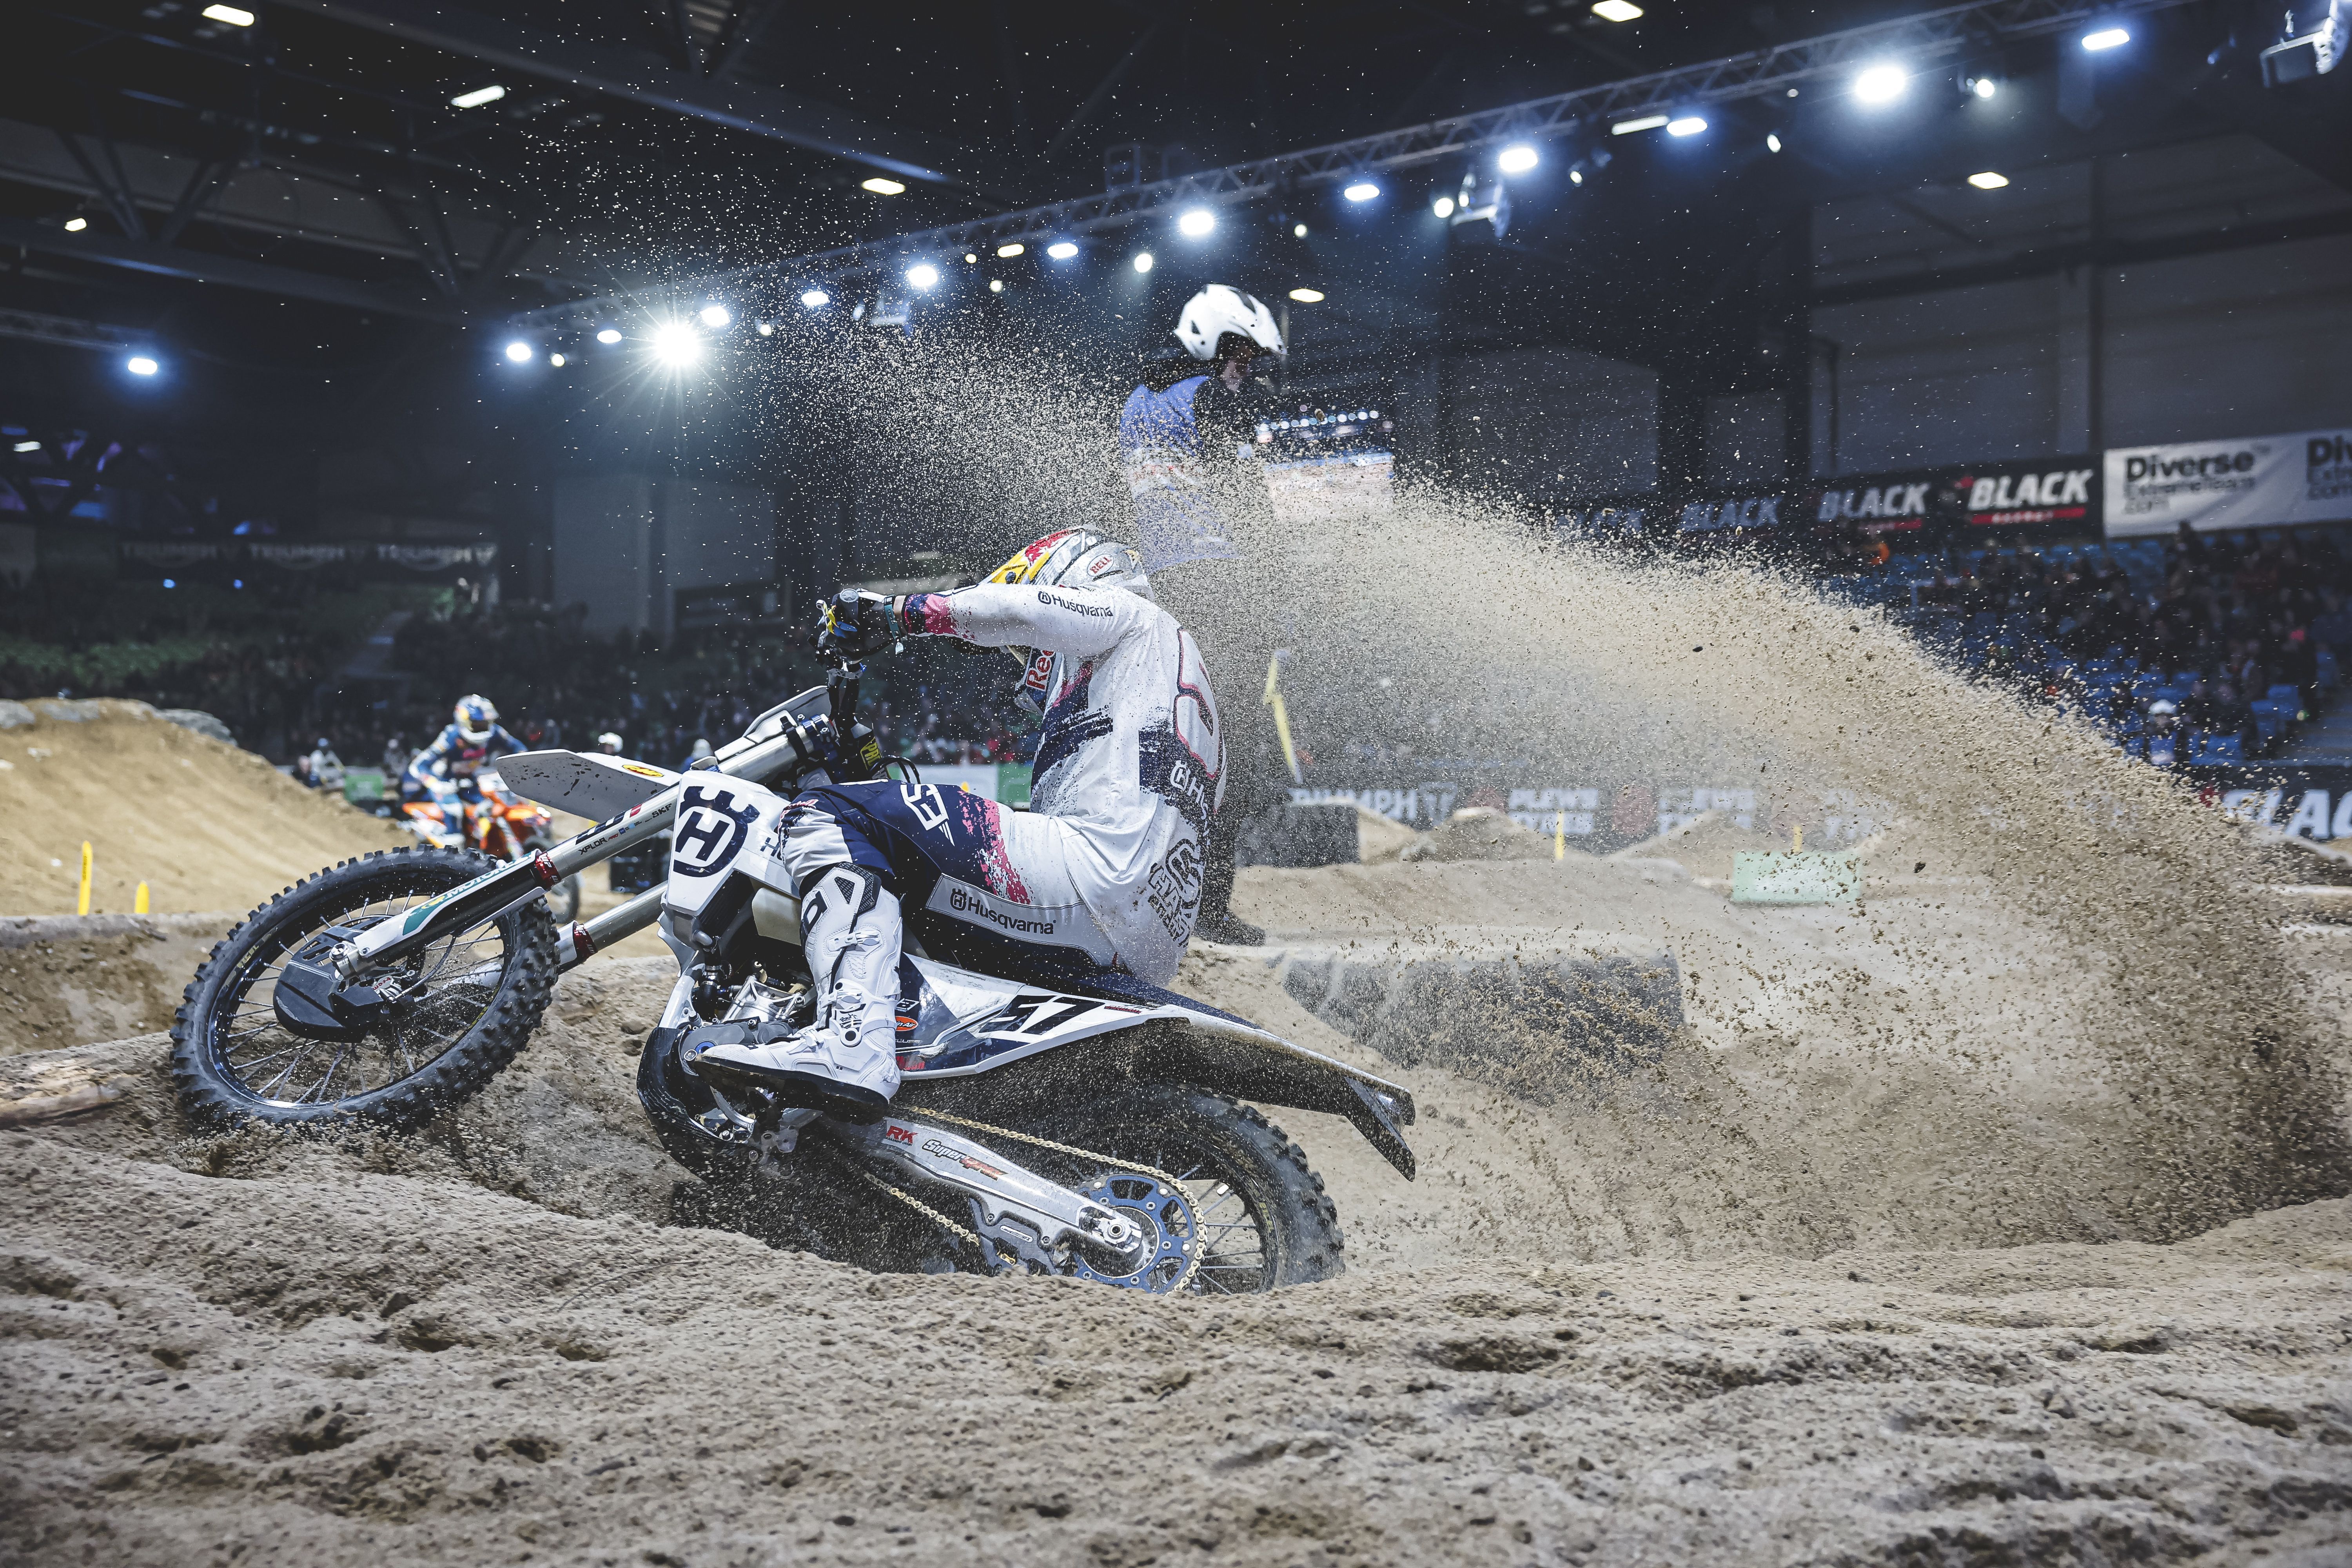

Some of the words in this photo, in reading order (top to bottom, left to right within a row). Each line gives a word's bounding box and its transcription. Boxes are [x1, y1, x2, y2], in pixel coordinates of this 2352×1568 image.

[2126, 451, 2255, 482] Diverse
[1968, 470, 2094, 509] BLACK
[1817, 483, 1932, 521] BLACK
[1090, 556, 1112, 574] BELL
[1052, 594, 1114, 619] Husqvarna
[651, 803, 672, 818] SKF
[577, 837, 608, 855] XPLOR
[967, 896, 1054, 935] Husqvarna
[372, 977, 391, 991] brem
[886, 1125, 919, 1144] RK
[922, 1139, 968, 1161] Super
